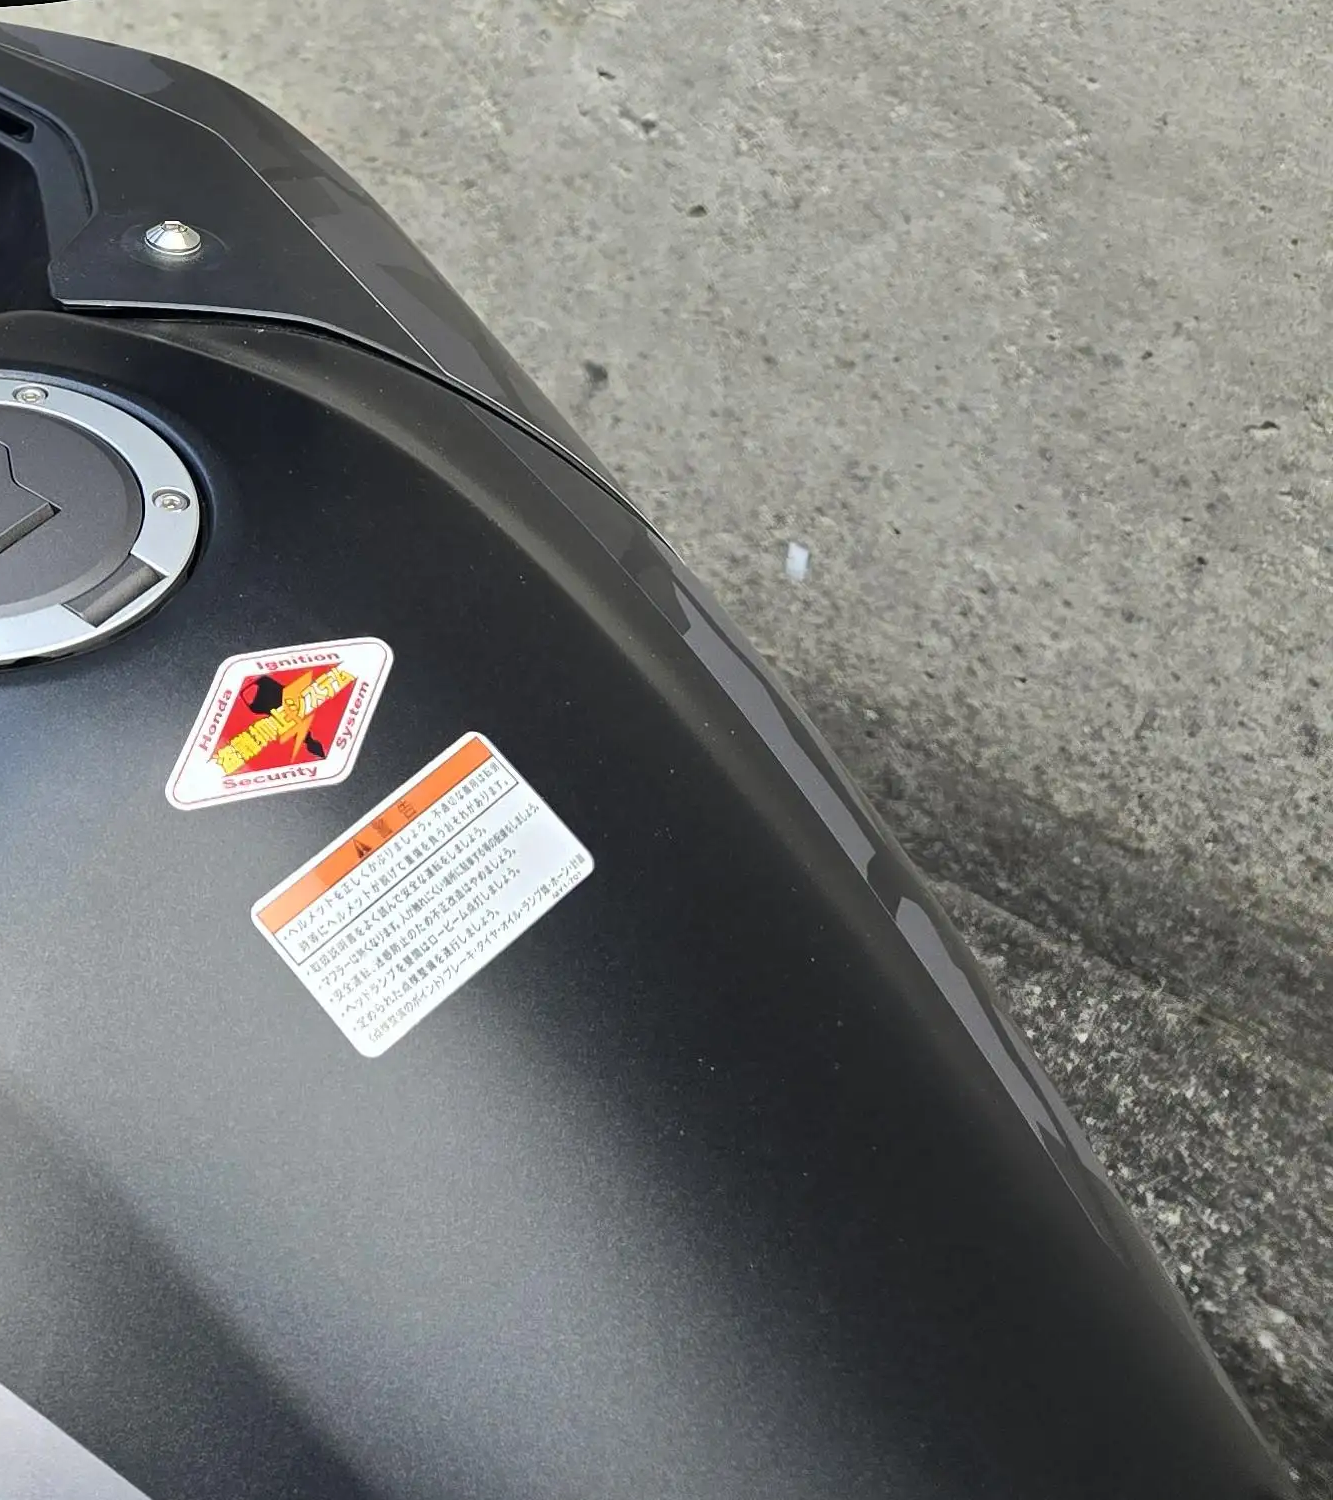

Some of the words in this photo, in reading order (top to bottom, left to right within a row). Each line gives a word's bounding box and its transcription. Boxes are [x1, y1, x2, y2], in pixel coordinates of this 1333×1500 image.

[256, 650, 341, 671] Ignition
[198, 688, 232, 752] Honda
[335, 680, 371, 752] System
[222, 764, 318, 791] Security
